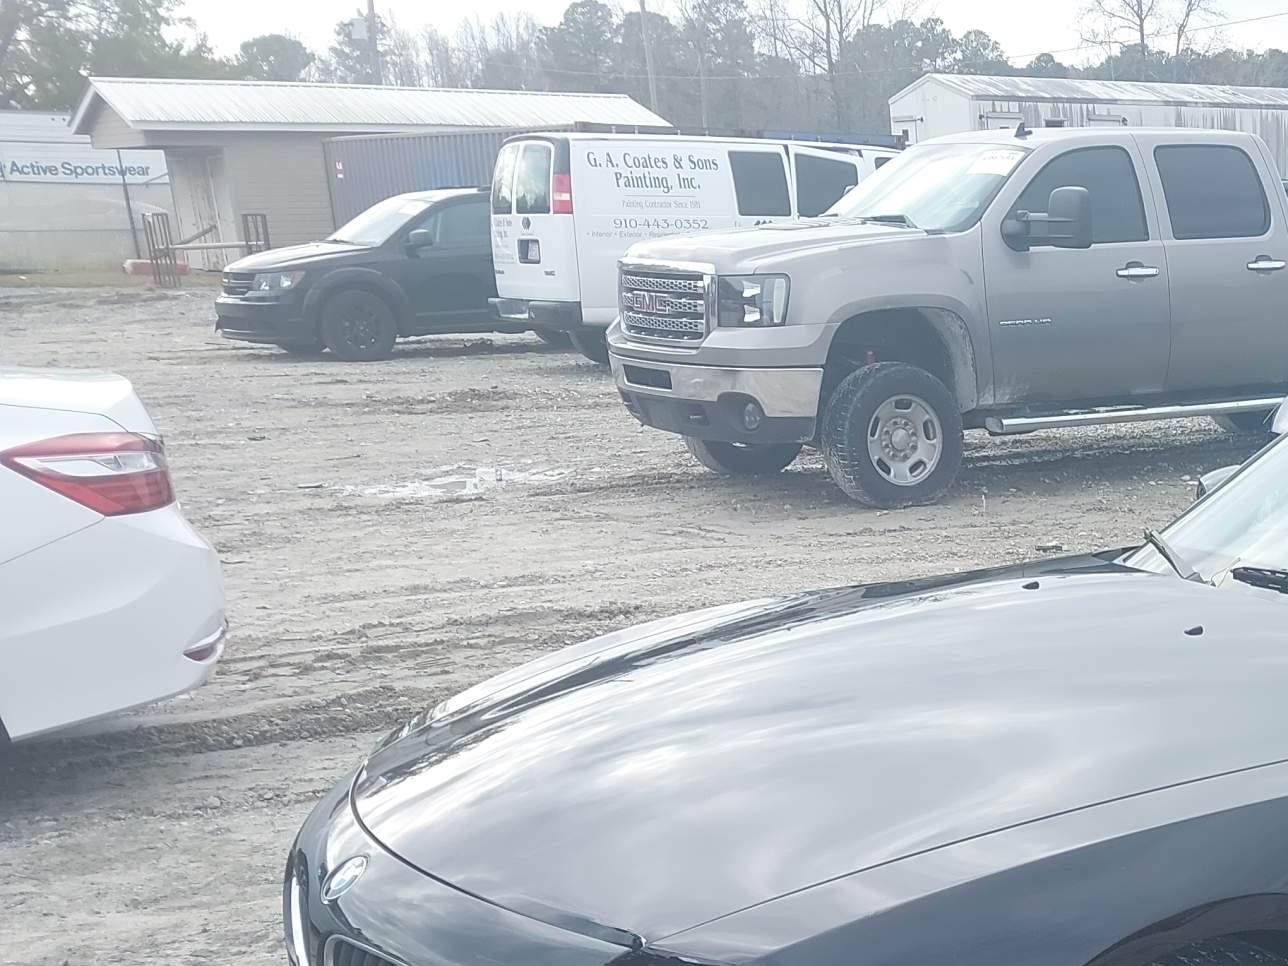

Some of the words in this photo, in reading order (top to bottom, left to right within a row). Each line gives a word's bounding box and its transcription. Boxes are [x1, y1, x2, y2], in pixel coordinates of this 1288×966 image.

[9, 160, 58, 176] Active
[61, 161, 150, 178] Sportswear
[587, 151, 602, 168] G.
[606, 152, 619, 168] A.
[623, 152, 668, 169] Coates
[673, 154, 684, 170] &
[688, 155, 719, 171] Sons
[614, 171, 673, 194] Painting,
[678, 173, 701, 190] Inc.
[613, 218, 709, 230] 910-443-0352
[632, 291, 669, 314] GMC
